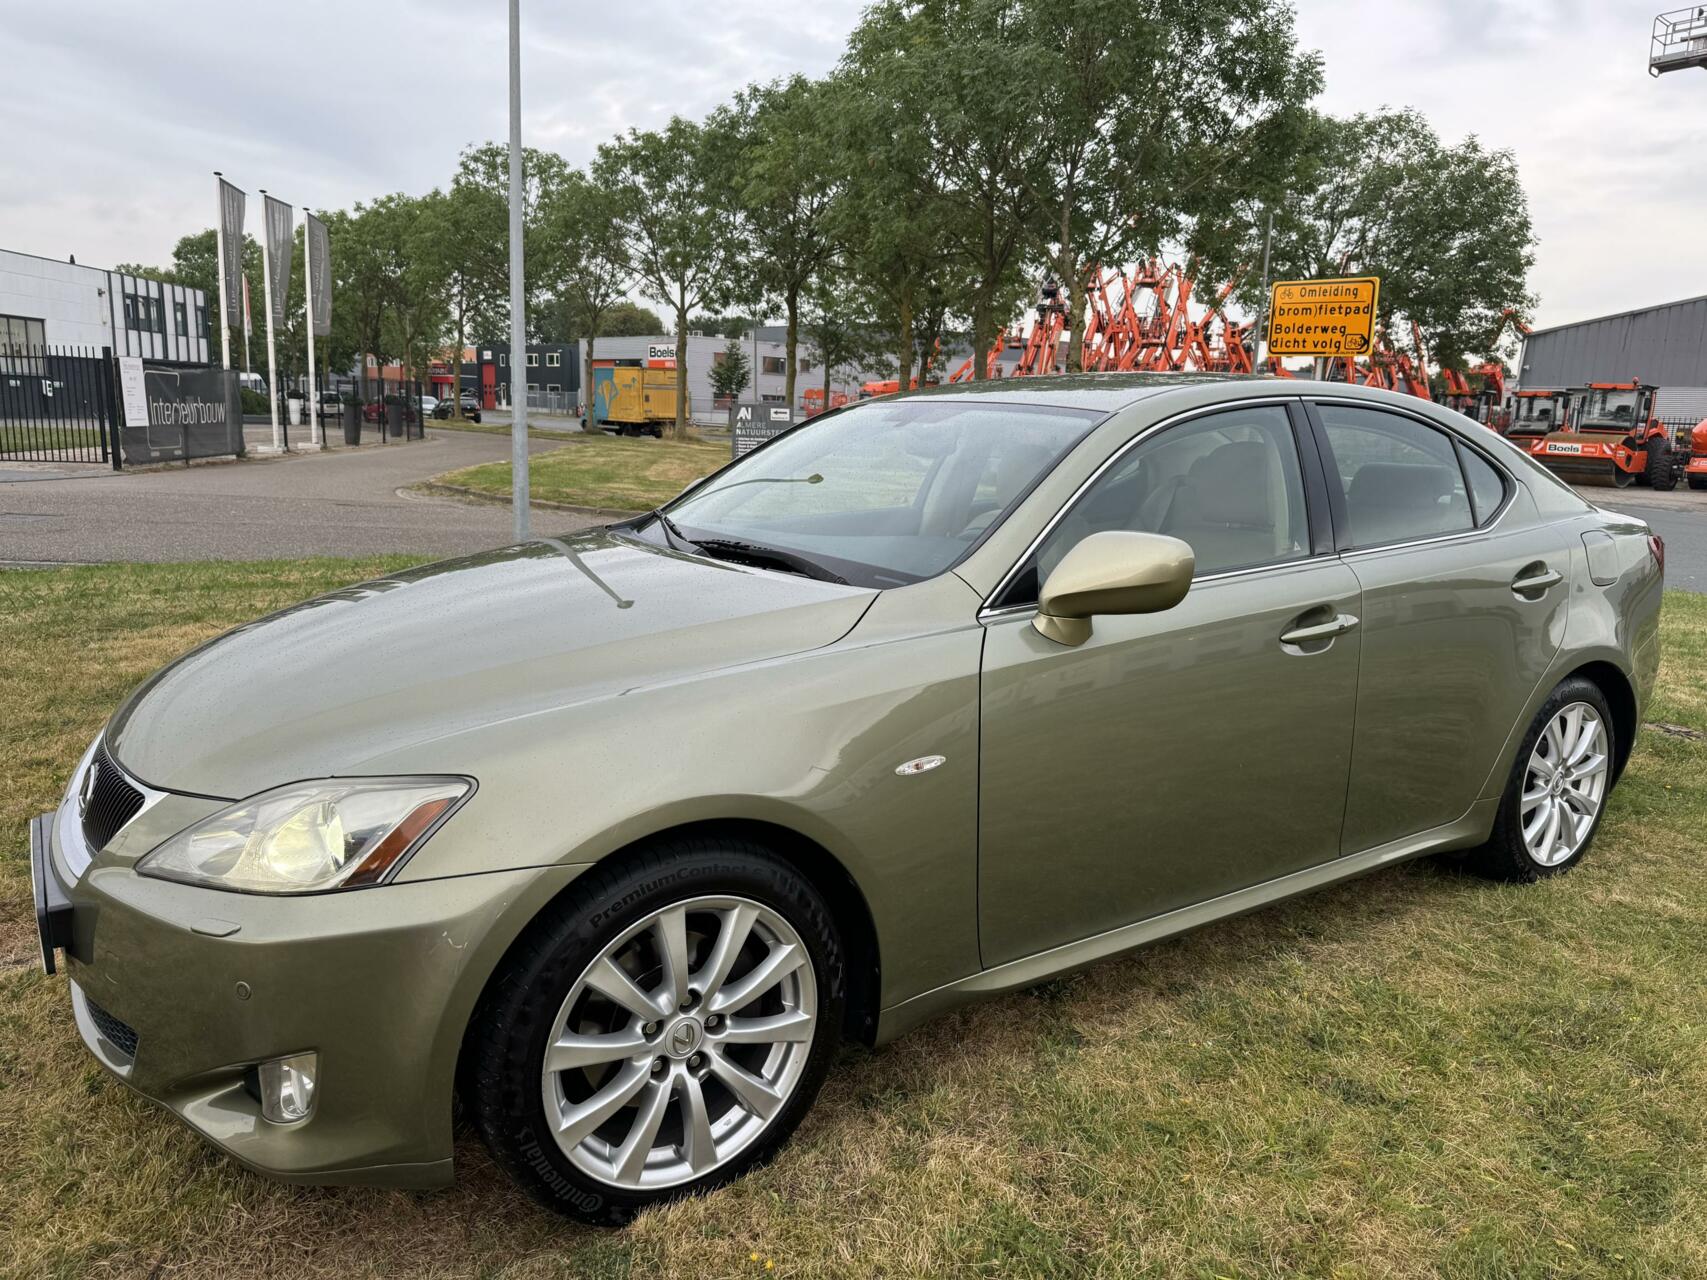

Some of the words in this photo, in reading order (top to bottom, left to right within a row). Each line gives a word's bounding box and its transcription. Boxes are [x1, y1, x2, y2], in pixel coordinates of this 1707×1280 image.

[1300, 286, 1358, 298] Omleiding
[1274, 323, 1347, 337] Bolderweg
[1271, 338, 1307, 349] dicht
[1313, 338, 1341, 352] volg
[649, 346, 675, 358] Boels
[149, 395, 226, 425] Interieurbouw
[1548, 444, 1580, 453] Boels
